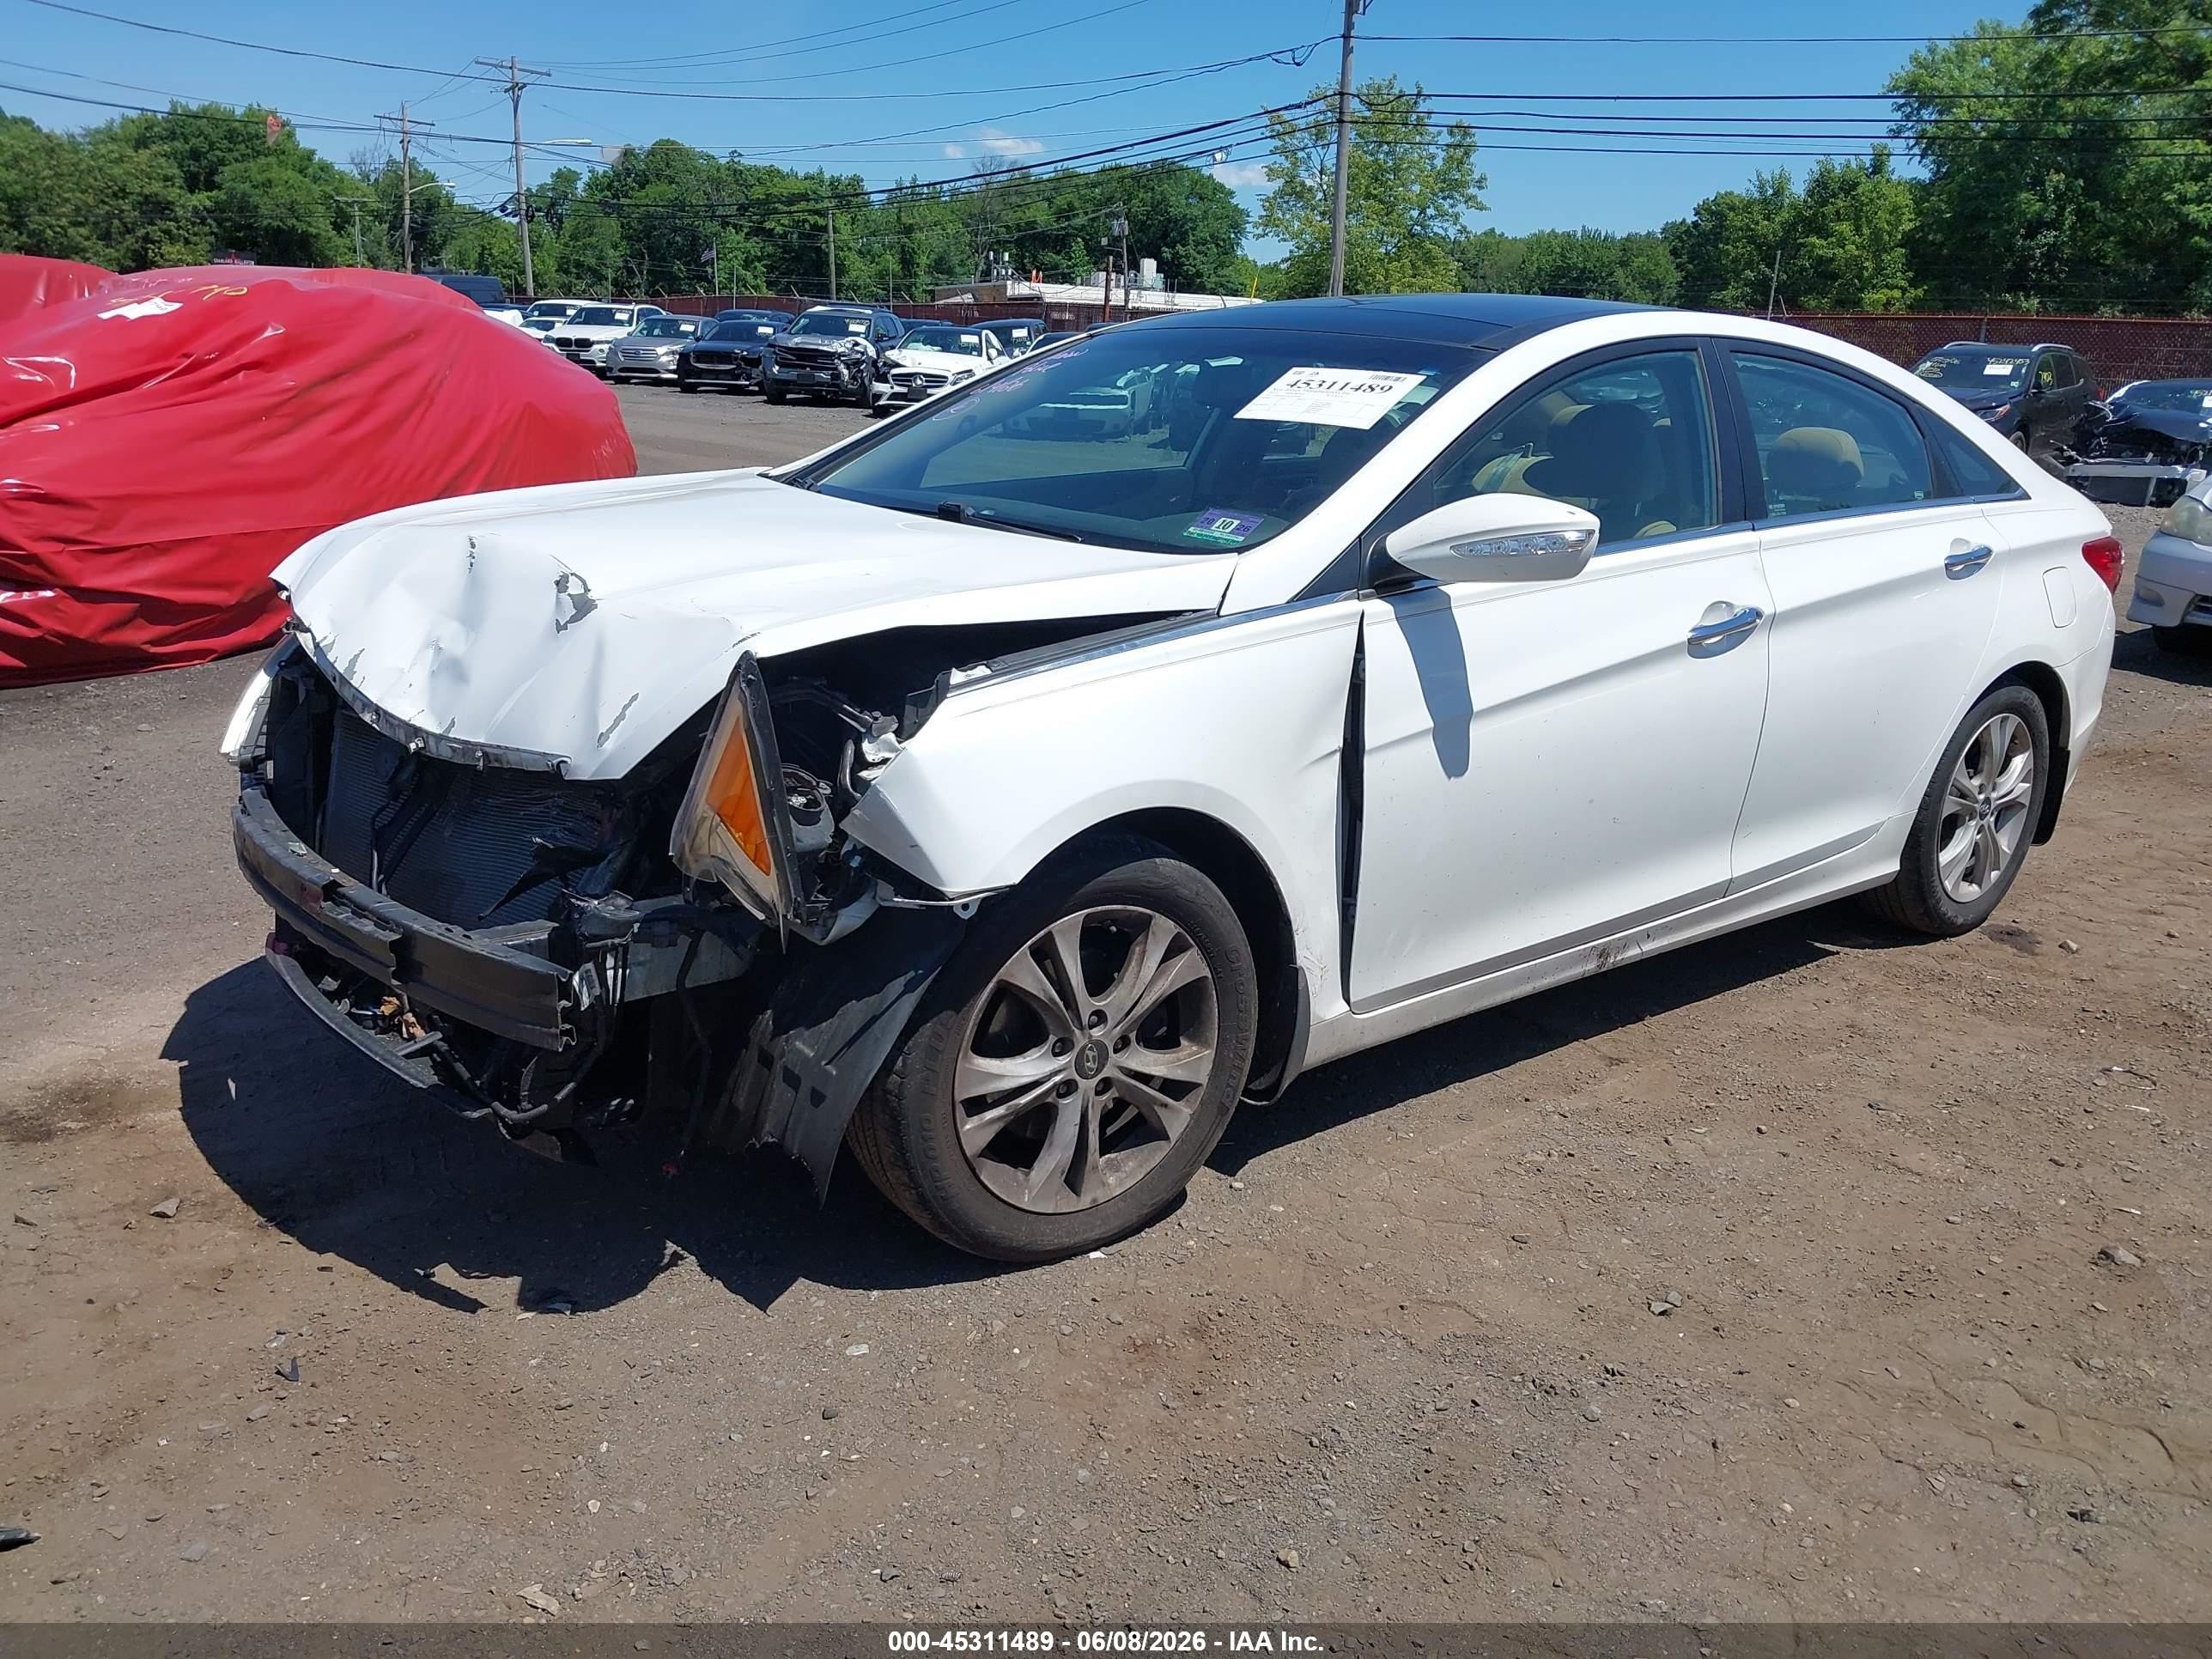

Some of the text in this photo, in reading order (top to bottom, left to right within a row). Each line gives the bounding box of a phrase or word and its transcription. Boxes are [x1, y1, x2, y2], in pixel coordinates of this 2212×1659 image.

[1286, 379, 1394, 394] 45311489
[1215, 520, 1235, 531] 10
[1236, 524, 1252, 532] 26
